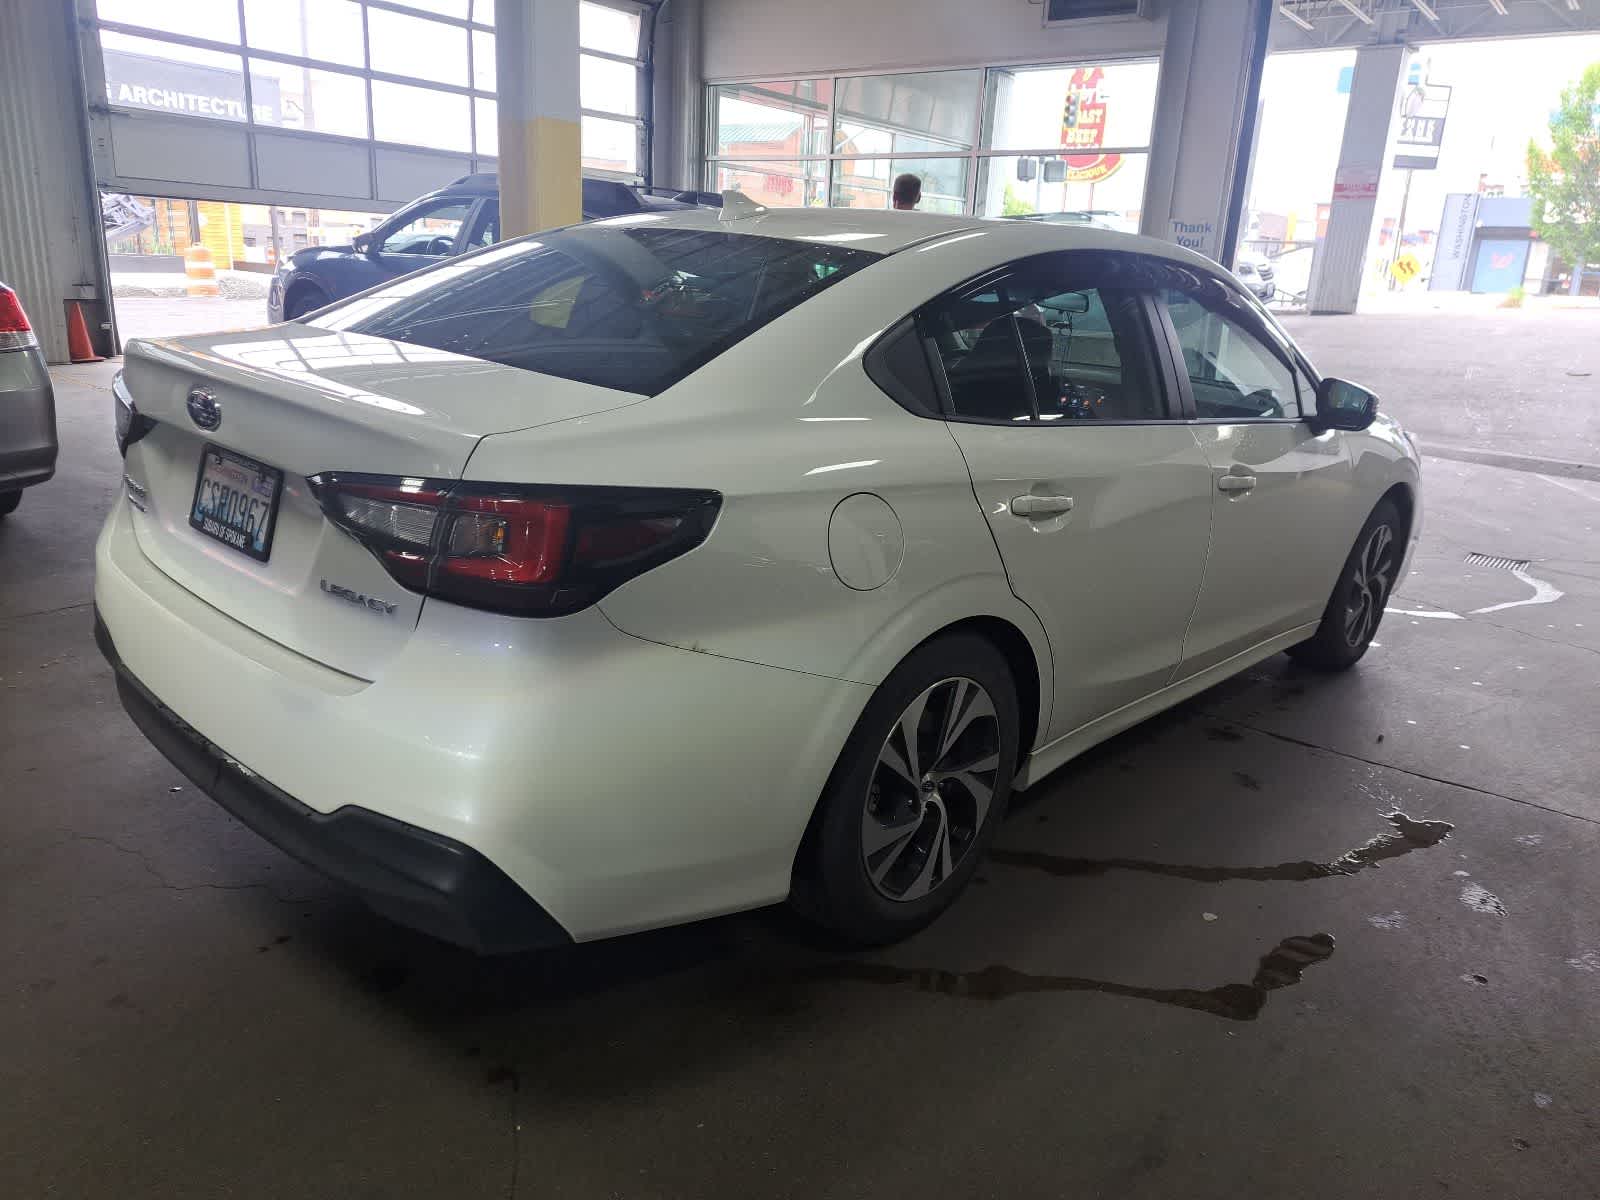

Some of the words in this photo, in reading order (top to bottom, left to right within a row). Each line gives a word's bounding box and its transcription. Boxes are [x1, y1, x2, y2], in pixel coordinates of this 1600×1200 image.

[1172, 221, 1212, 233] Thank
[1176, 234, 1205, 247] You!
[225, 527, 246, 549] SPOKANE
